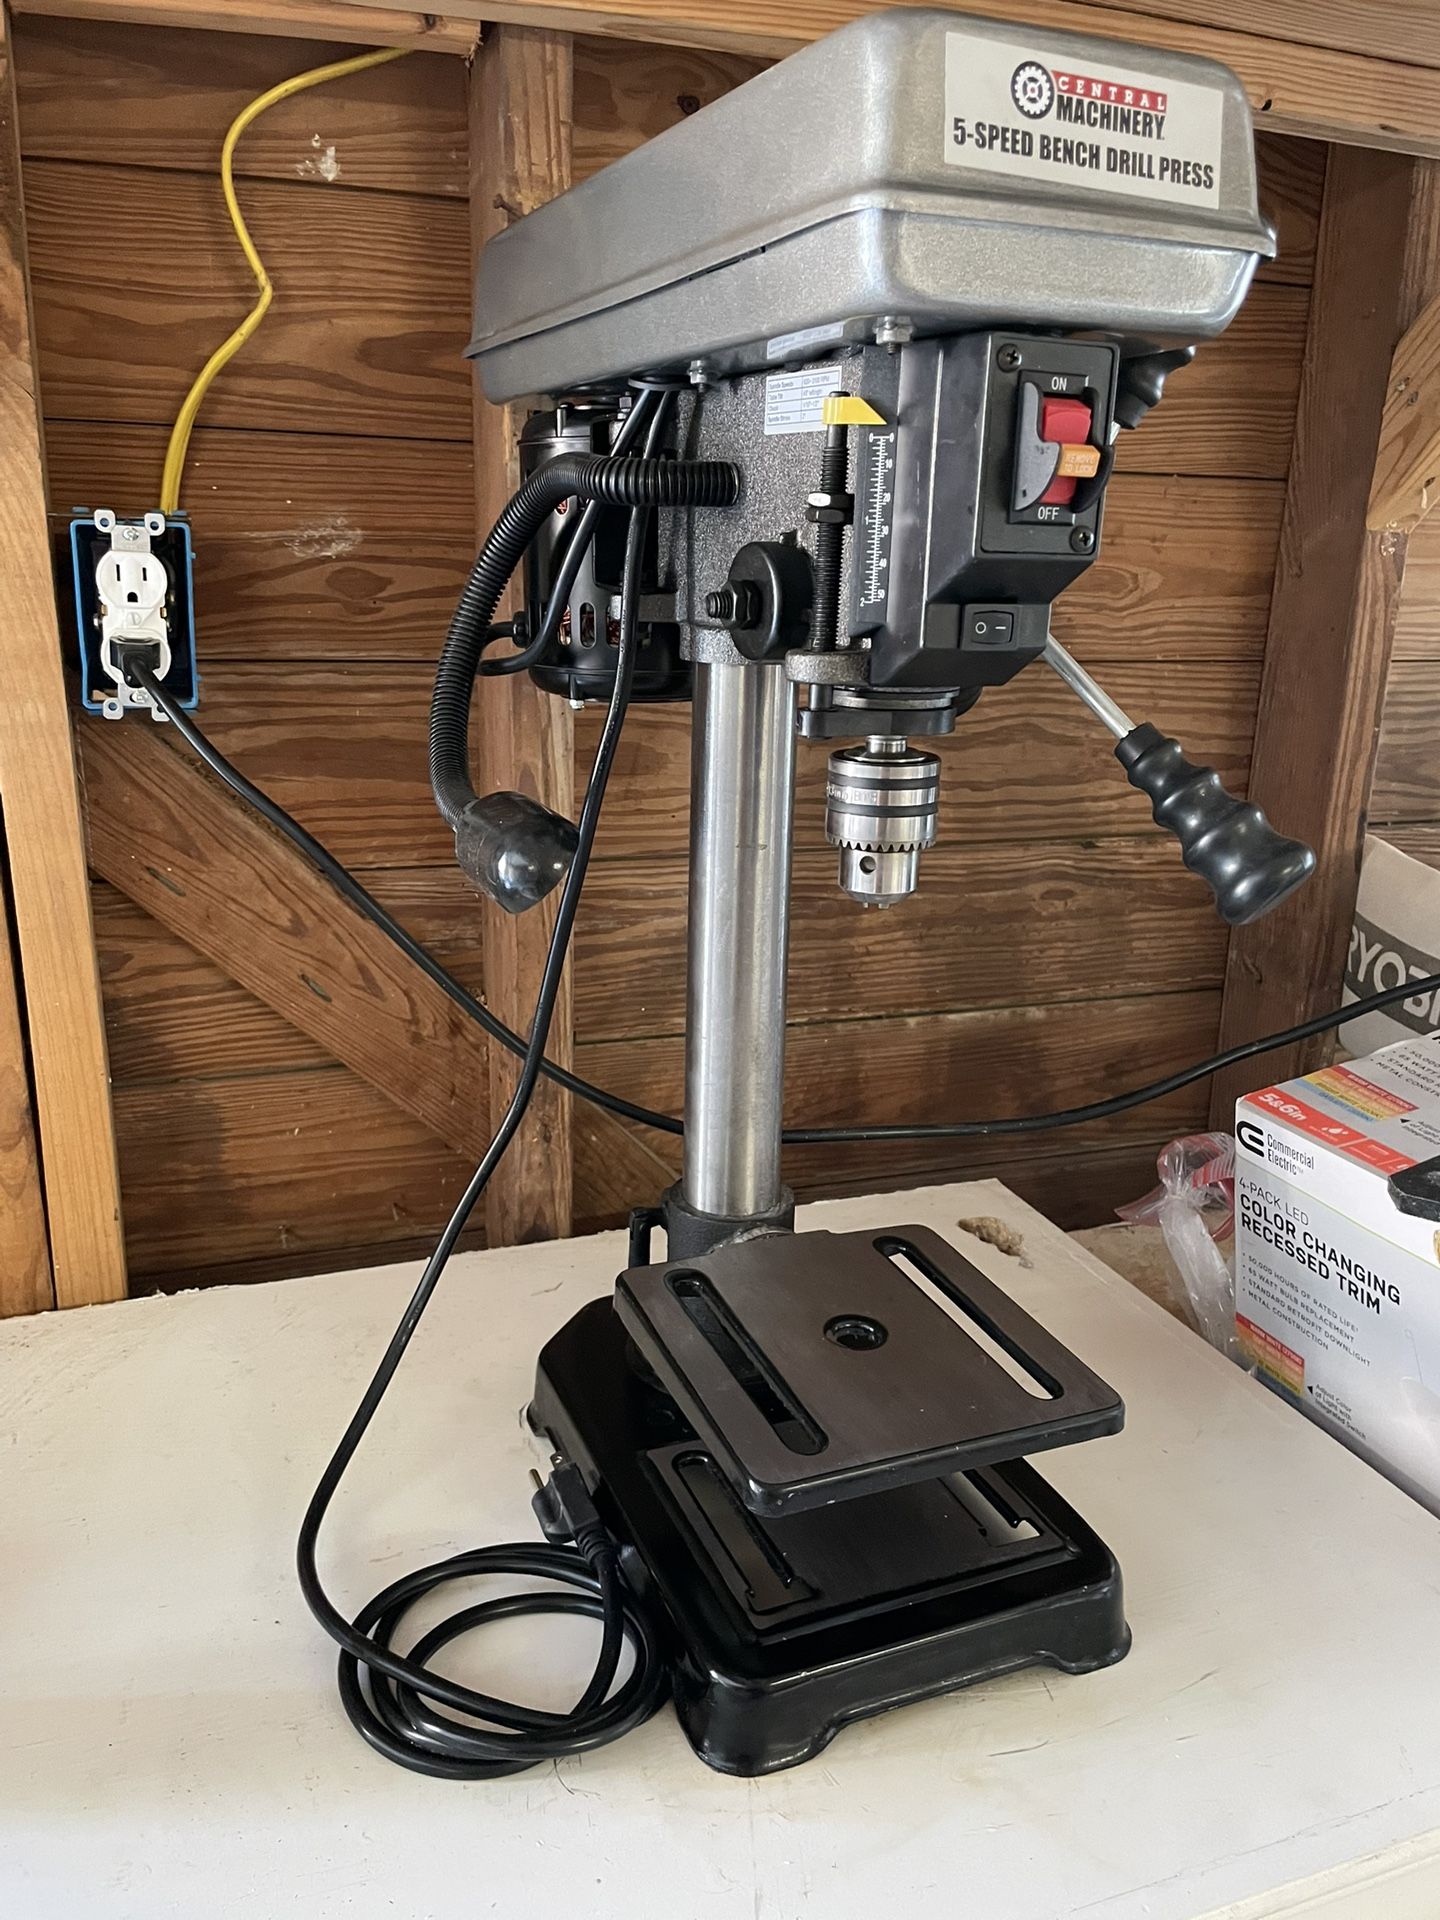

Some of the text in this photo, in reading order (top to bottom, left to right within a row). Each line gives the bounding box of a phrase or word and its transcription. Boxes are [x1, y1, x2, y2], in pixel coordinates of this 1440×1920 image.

[1057, 75, 1166, 112] CENTRAL
[1056, 94, 1166, 141] MACHINERY
[952, 116, 1214, 191] 5-SPEED BENCH DRILL PRESS
[1051, 376, 1068, 392] ON
[885, 458, 893, 469] 10
[883, 492, 891, 503] 20
[1037, 506, 1060, 521] OFF
[881, 525, 889, 536] 30
[879, 558, 888, 569] 40
[859, 597, 865, 608] 2
[878, 589, 886, 599] 50
[1375, 1061, 1403, 1079] METAL
[1387, 1057, 1434, 1084] STANDARD
[1267, 1133, 1315, 1170] Commercial
[1238, 1176, 1309, 1226] 4-PACK LED
[1239, 1193, 1401, 1306] COLOR CHANGING
[1241, 1212, 1382, 1315] RECESSED TRIM
[1258, 1273, 1278, 1291] WATT
[1280, 1286, 1299, 1305] BULB
[1300, 1302, 1355, 1343] REPLACEMENT
[1274, 1271, 1299, 1294] HOURS
[1300, 1289, 1311, 1301] OF
[1313, 1296, 1338, 1319] RATED
[1248, 1290, 1272, 1311] METAL
[1272, 1306, 1330, 1351] CONSTRUCTION
[1248, 1278, 1286, 1309] STANDARD
[1287, 1304, 1323, 1334] RETROFIT
[1324, 1330, 1371, 1368] DOWNLIGHT
